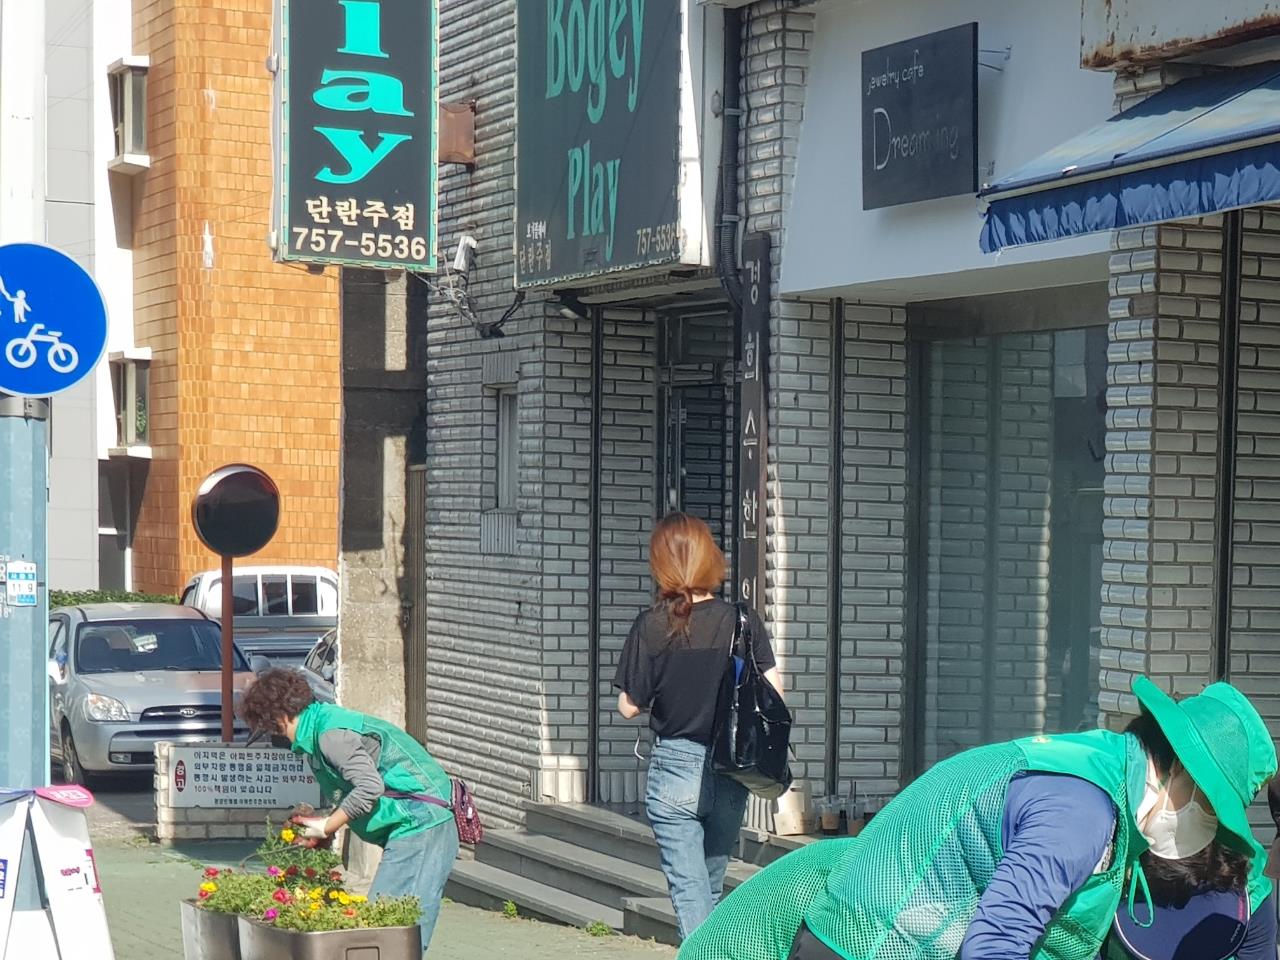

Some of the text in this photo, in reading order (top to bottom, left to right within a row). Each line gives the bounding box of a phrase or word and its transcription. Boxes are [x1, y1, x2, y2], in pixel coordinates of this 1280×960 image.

[545, 0, 645, 124] Bogey
[867, 57, 900, 96] jewelry
[305, 195, 415, 231] 단란주점
[566, 140, 621, 262] Play
[292, 226, 426, 260] 757-5536
[635, 222, 677, 256] 757-5536
